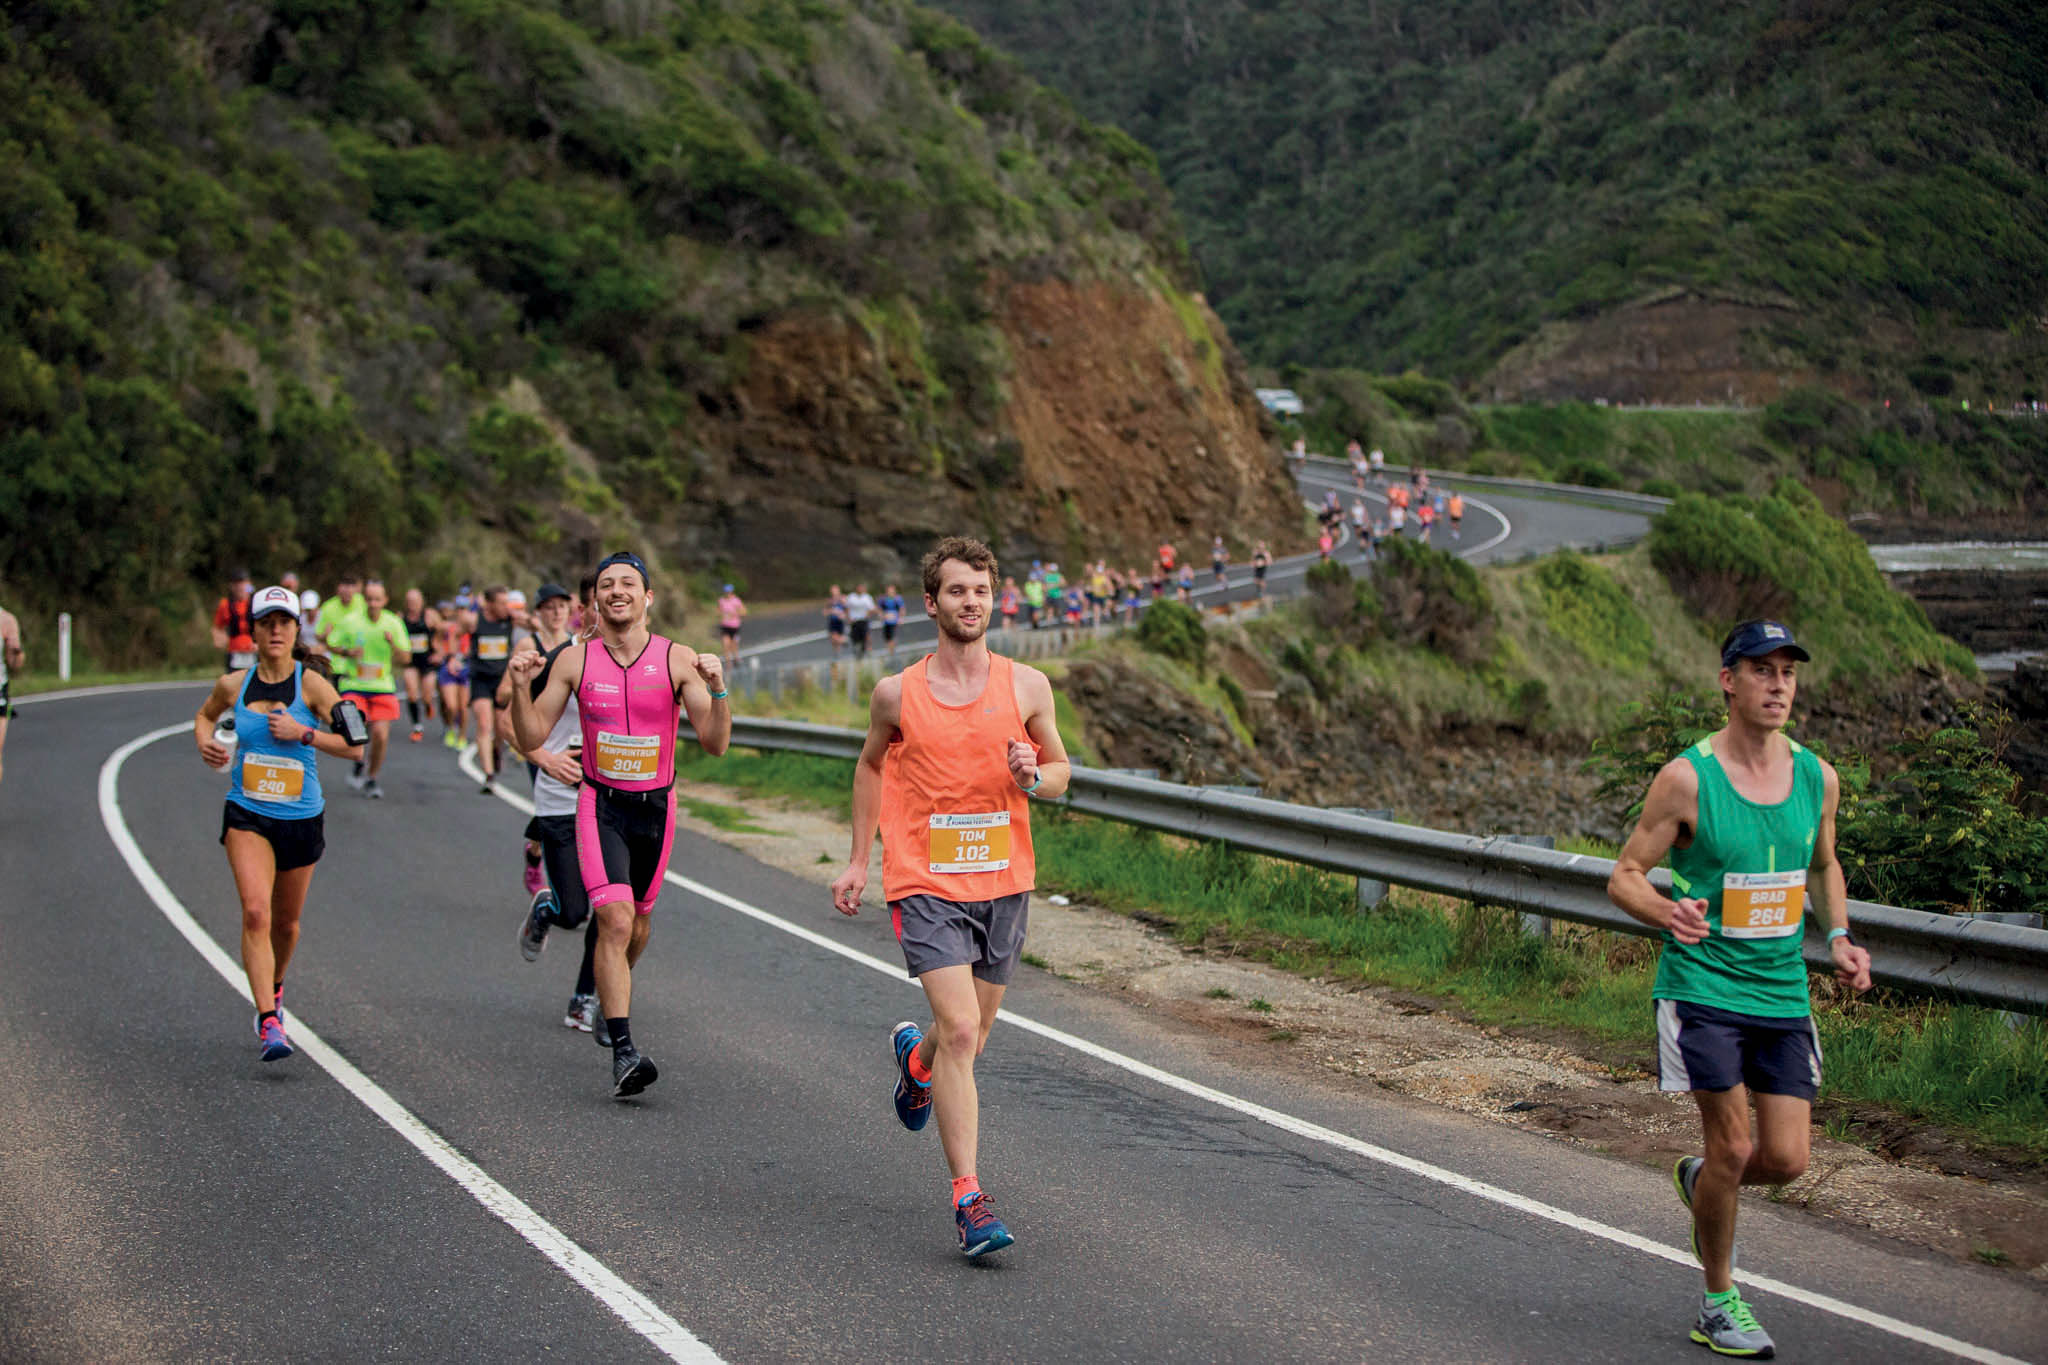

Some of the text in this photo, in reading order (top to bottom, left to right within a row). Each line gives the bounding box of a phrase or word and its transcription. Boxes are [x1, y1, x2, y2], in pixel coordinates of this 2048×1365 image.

[613, 758, 642, 772] 304
[266, 769, 278, 778] EL
[257, 779, 286, 793] 240
[959, 830, 986, 842] TOM
[954, 845, 990, 861] 102
[1750, 890, 1786, 904] BRAD
[1748, 907, 1786, 925] 264
